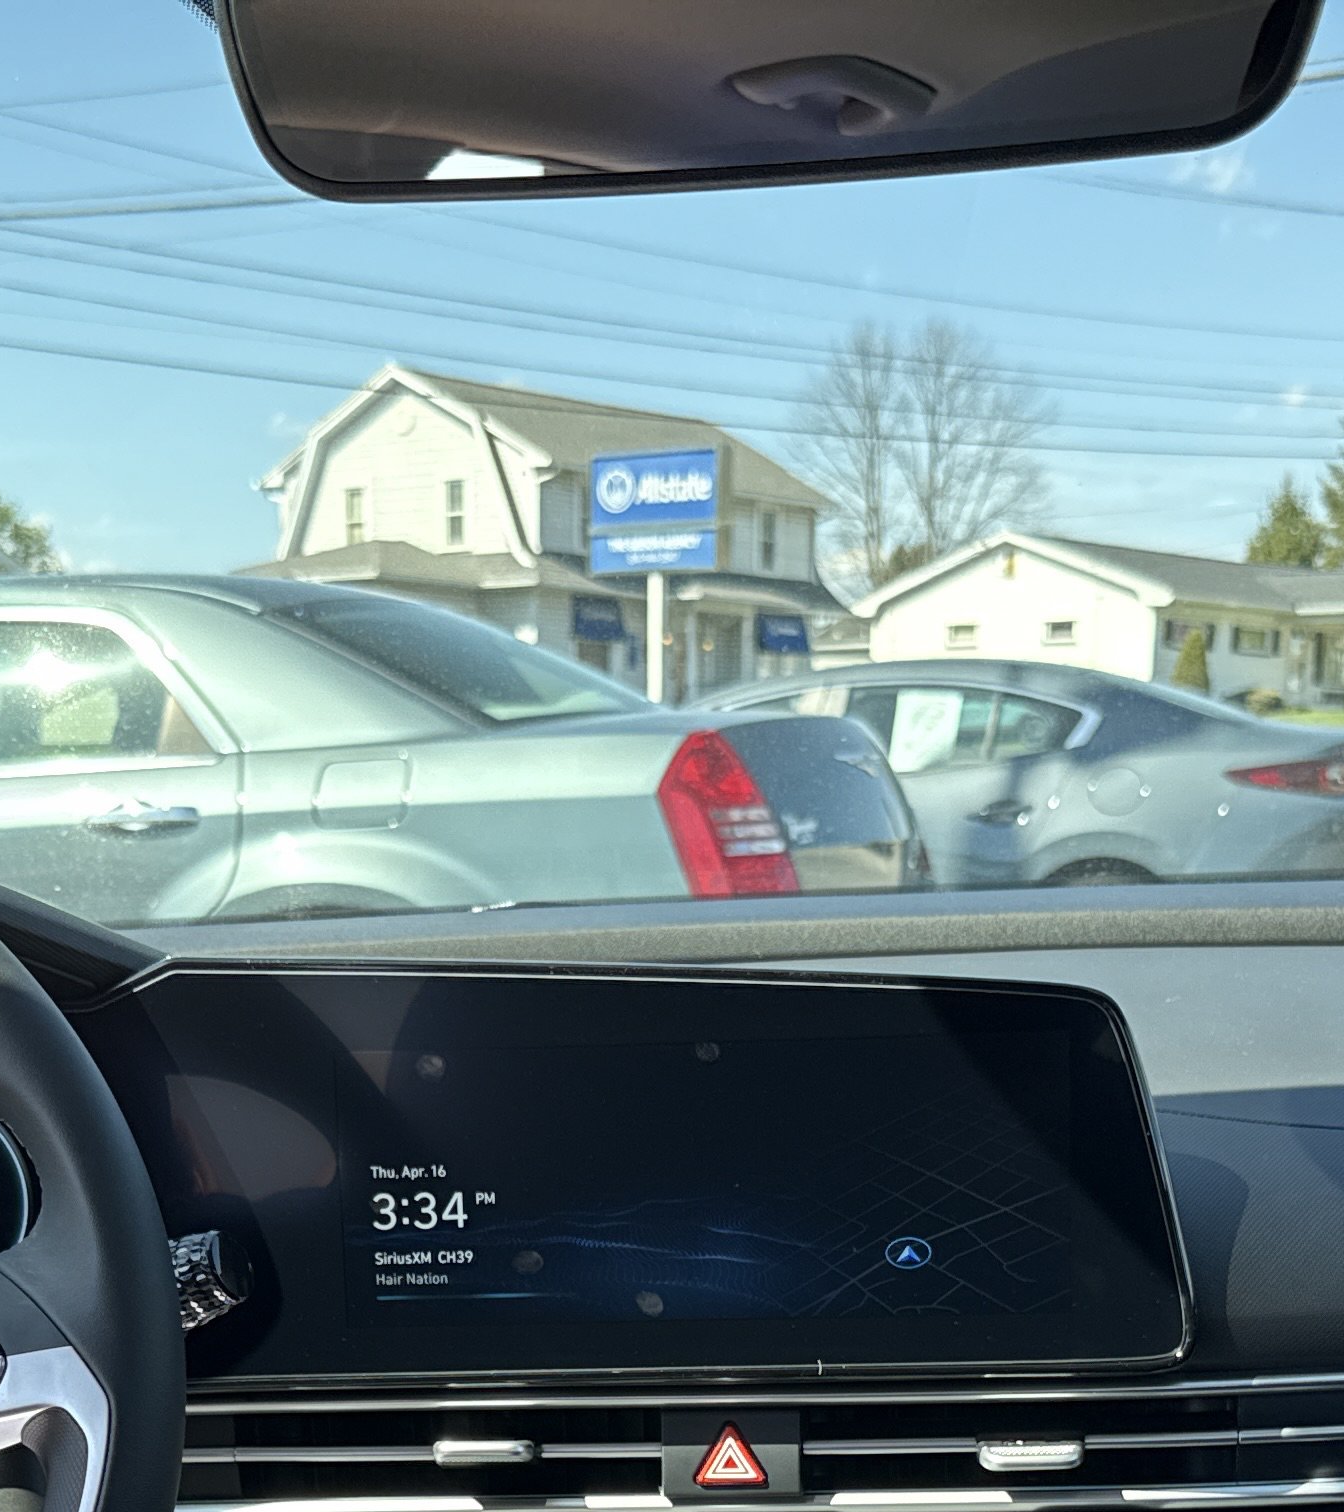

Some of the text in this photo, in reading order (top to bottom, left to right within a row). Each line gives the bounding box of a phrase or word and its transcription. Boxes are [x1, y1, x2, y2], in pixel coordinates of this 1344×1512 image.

[370, 1164, 447, 1181] Thu, Apr. 16
[372, 1191, 496, 1231] 3:34 PM
[374, 1250, 474, 1266] SiriusXM CH39
[375, 1272, 449, 1286] Hair Nation
